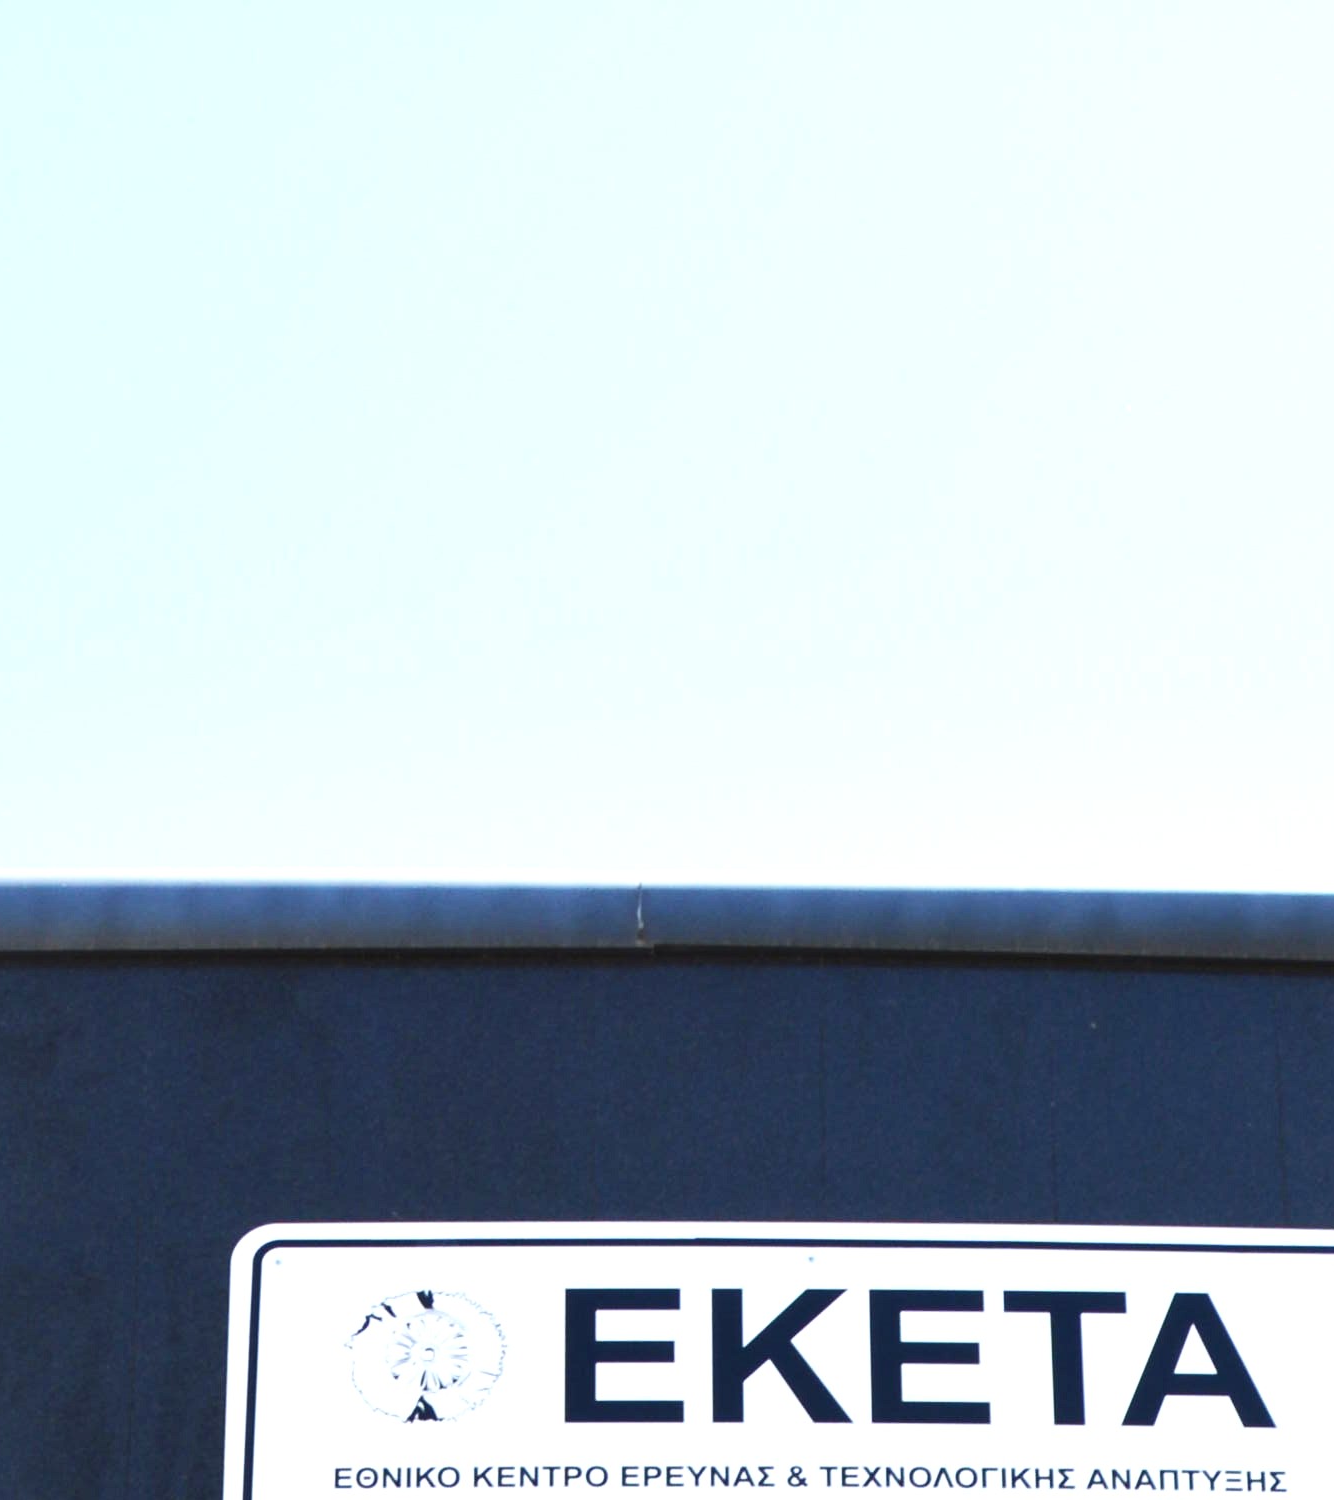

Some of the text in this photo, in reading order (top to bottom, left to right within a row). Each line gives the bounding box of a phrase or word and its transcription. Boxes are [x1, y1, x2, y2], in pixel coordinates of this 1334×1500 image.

[565, 1289, 1276, 1429] ΕΚΕΤΑ
[334, 1465, 1287, 1493] ΕΘΝΙΚΟ ΚΕΝΤΡΟ ΕΡΕΥΝΑΣ & ΤΕΧΝΟΛΟΓΙΚΗΣ ΑΝΑΠΤΥΞΗΣ
